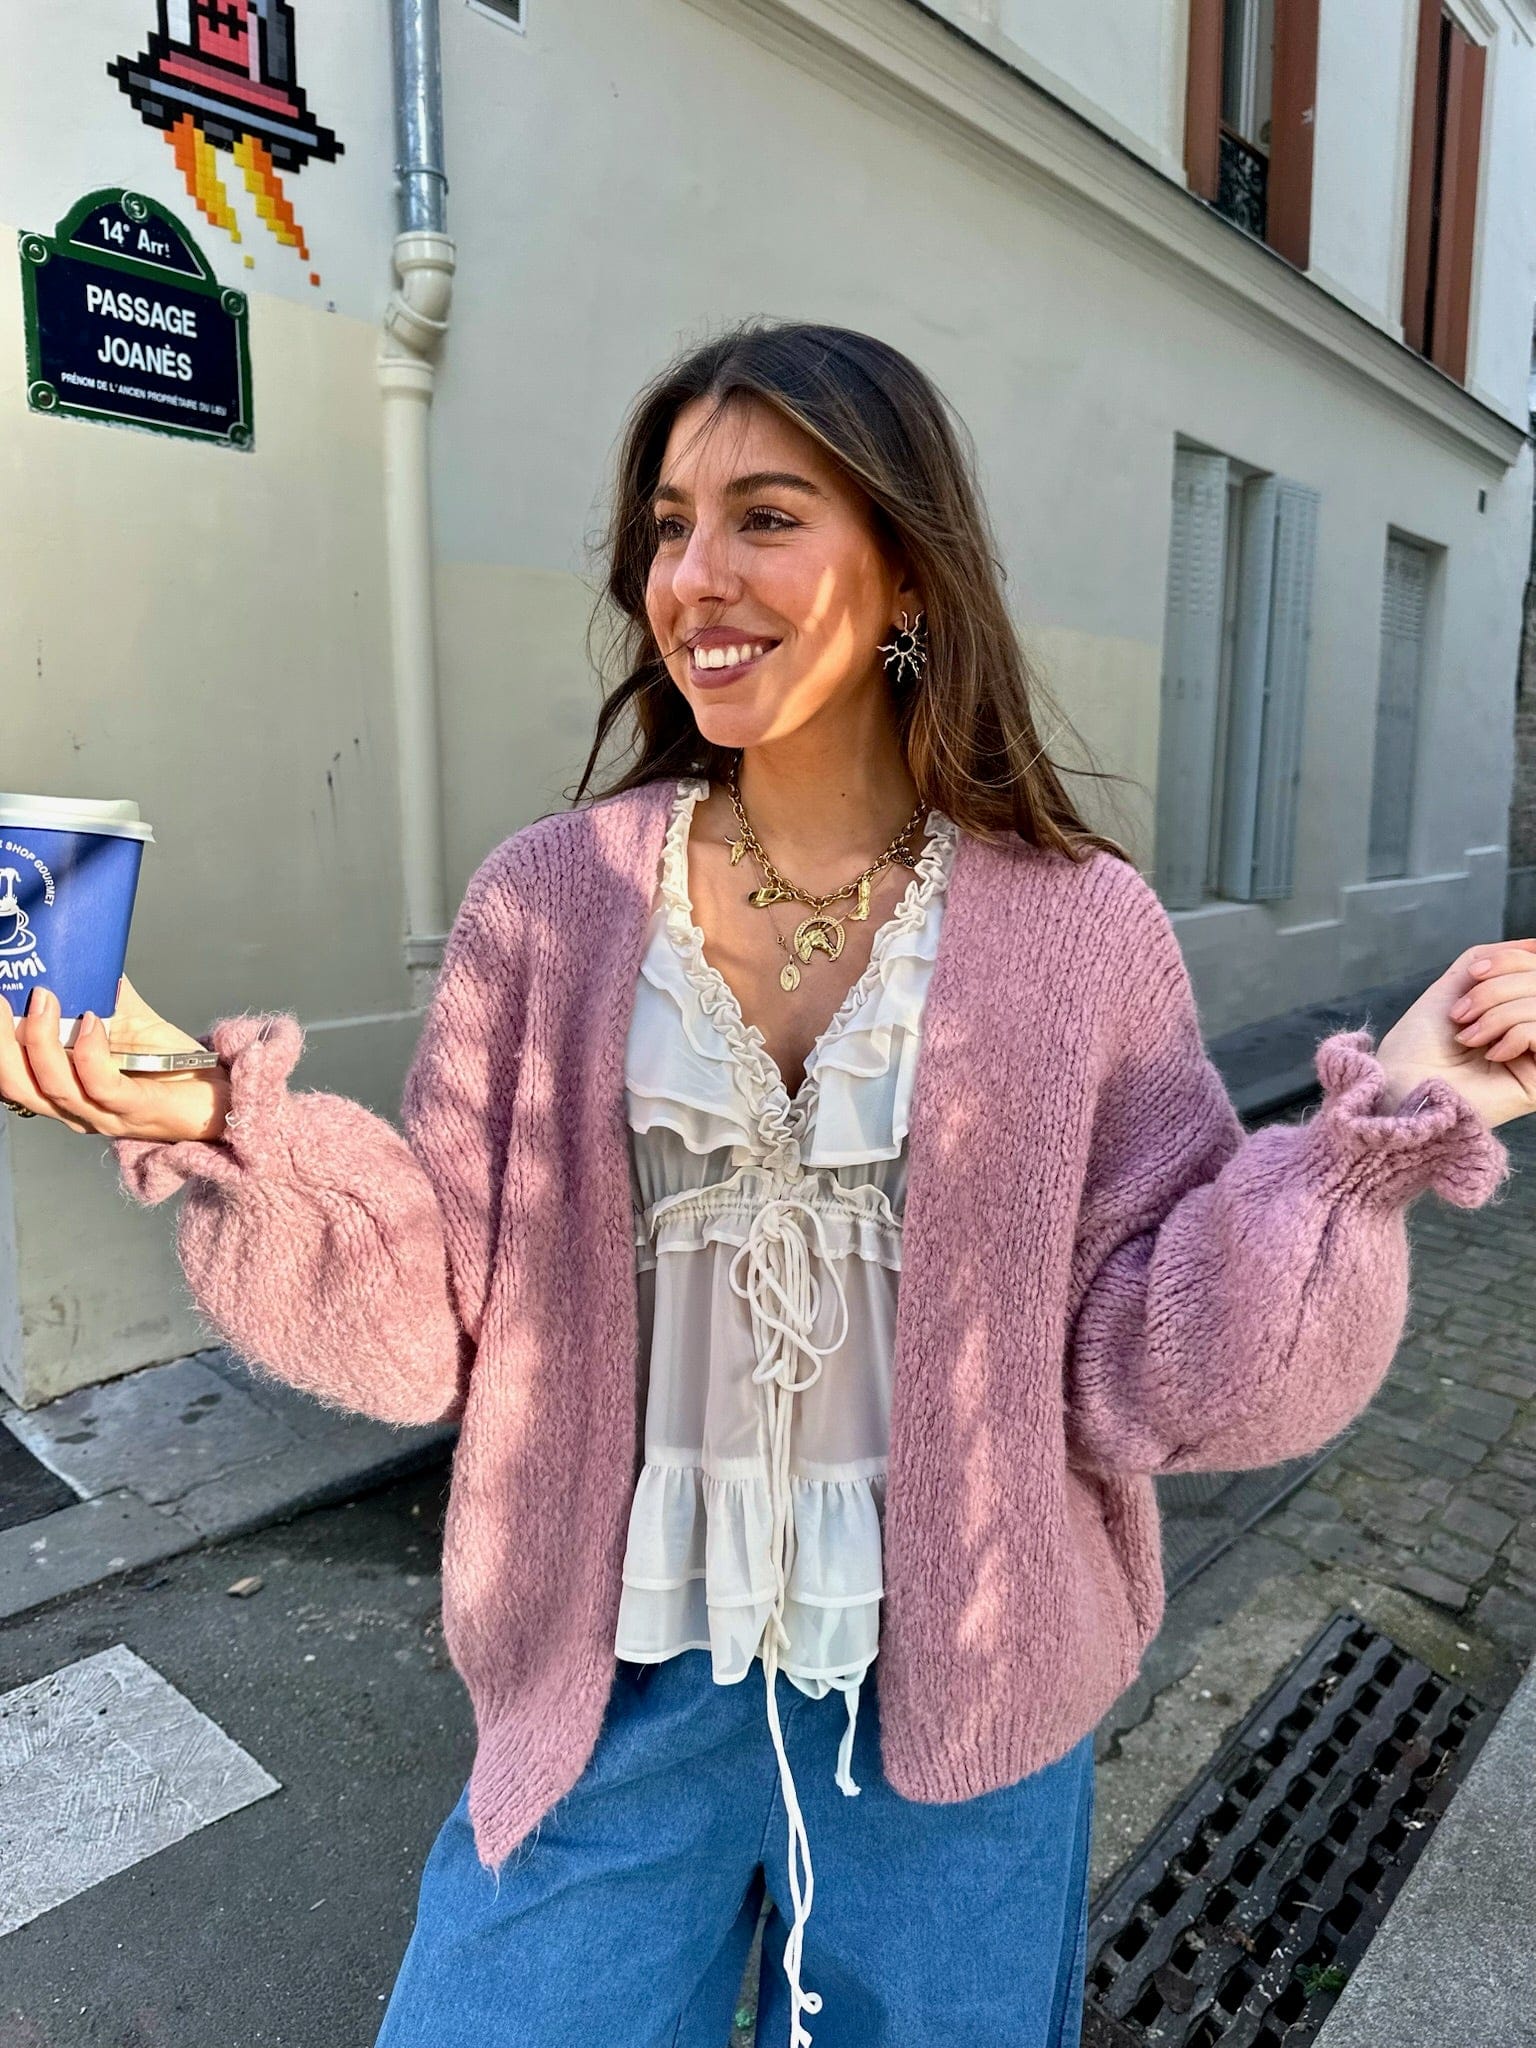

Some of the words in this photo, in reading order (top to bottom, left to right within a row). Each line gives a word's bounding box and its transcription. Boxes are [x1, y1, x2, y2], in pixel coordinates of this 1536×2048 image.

[86, 284, 198, 338] PASSAGE
[61, 372, 96, 389] PRÉNOM
[96, 380, 108, 391] DE
[97, 335, 193, 381] JOANÈS
[5, 841, 36, 860] SHOP
[34, 859, 56, 907] GOURMET
